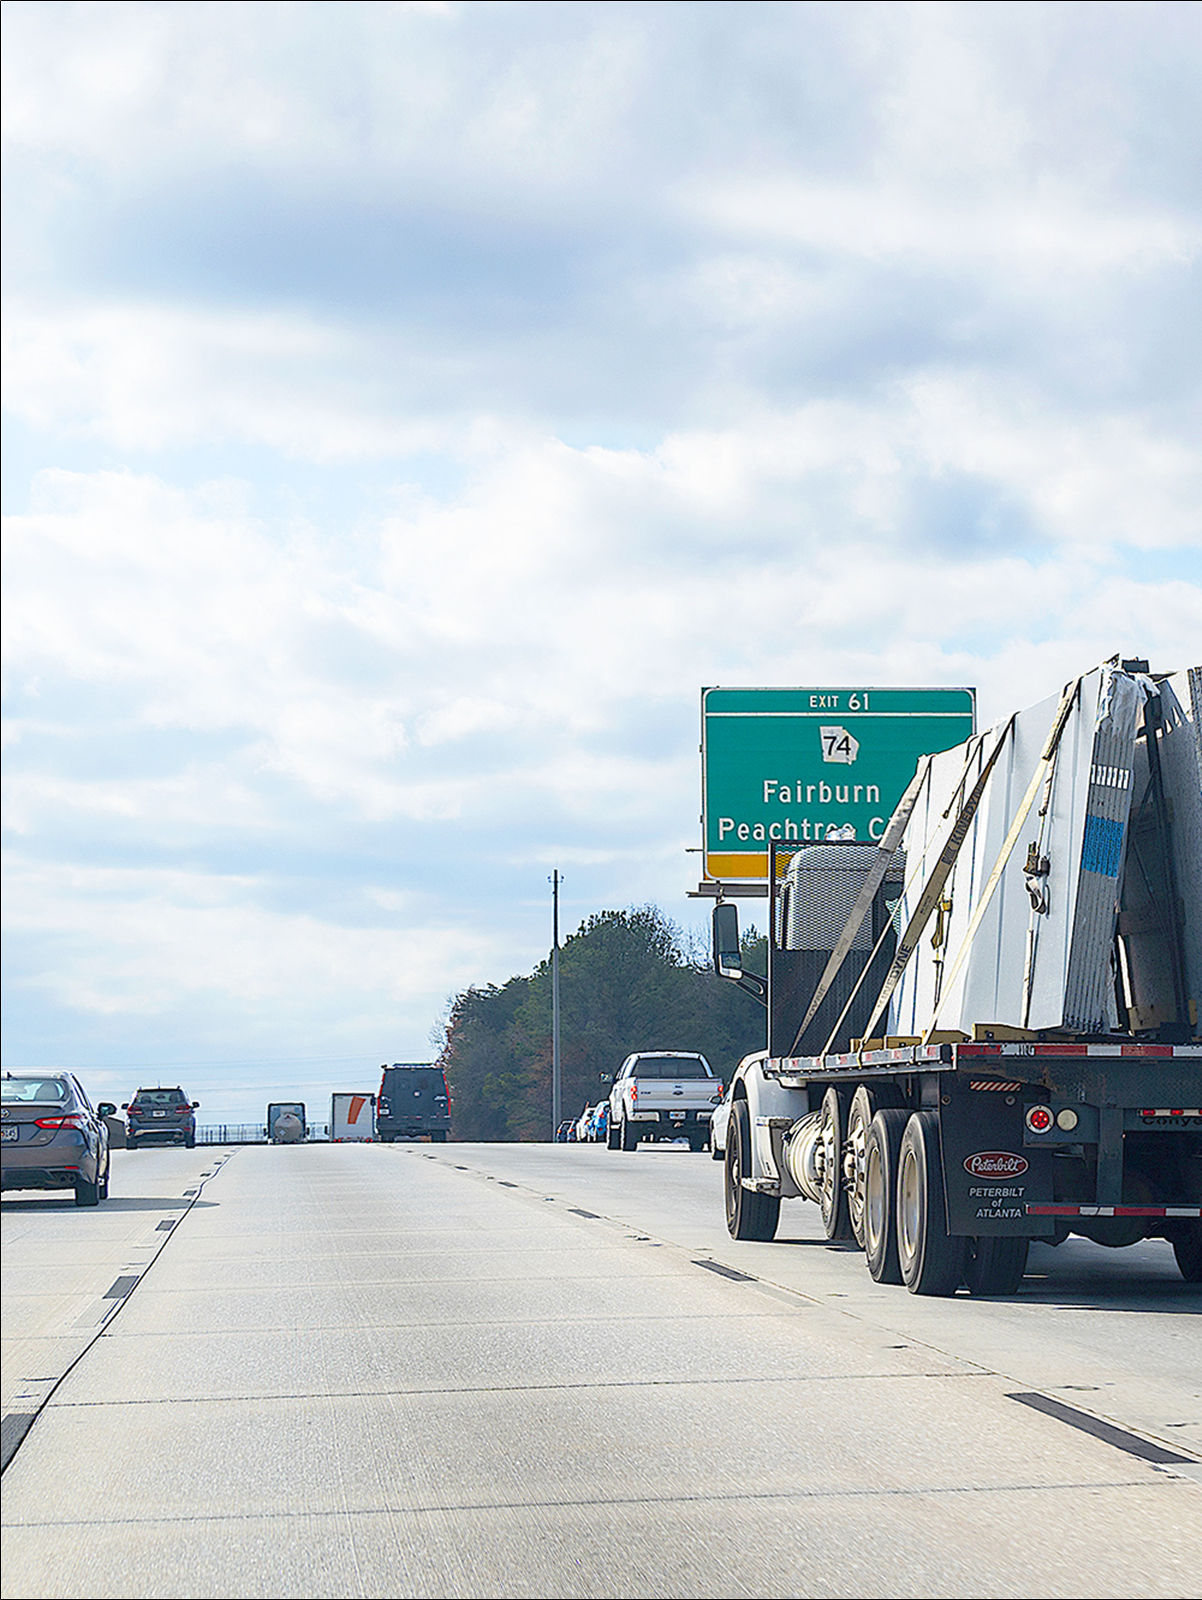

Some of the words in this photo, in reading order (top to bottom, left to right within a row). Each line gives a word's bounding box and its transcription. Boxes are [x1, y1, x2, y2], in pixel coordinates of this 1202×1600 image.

[809, 695, 839, 708] EXIT
[848, 692, 869, 711] 61
[823, 735, 852, 756] 74
[763, 780, 880, 803] Fairburn
[971, 1156, 1022, 1172] Peterbilt
[969, 1187, 1025, 1197] PETERBILT
[991, 1198, 1003, 1208] of
[976, 1208, 1022, 1218] ATLANTA
